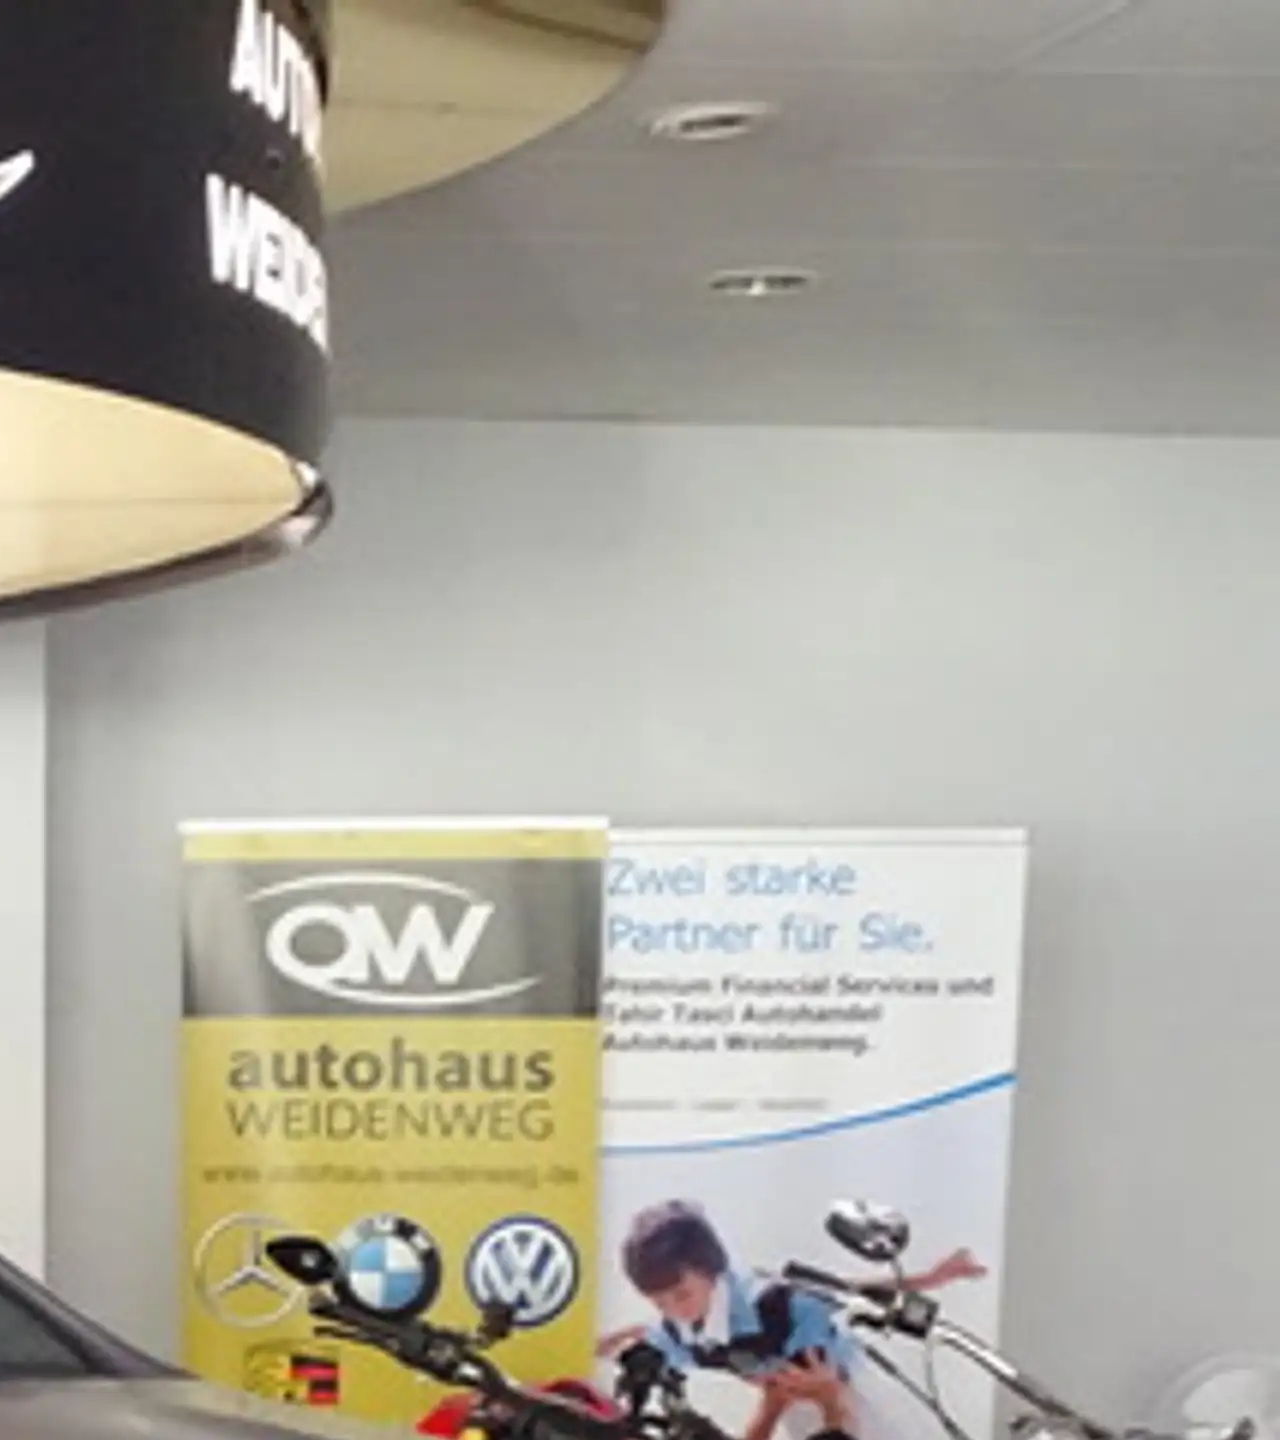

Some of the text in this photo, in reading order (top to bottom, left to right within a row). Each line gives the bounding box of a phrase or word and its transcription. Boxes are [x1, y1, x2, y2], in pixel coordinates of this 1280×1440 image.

[607, 856, 857, 896] Zwei starke
[607, 910, 935, 953] Partner für Sie.
[226, 1038, 556, 1093] autohaus
[226, 1098, 556, 1142] WEIDENWEG
